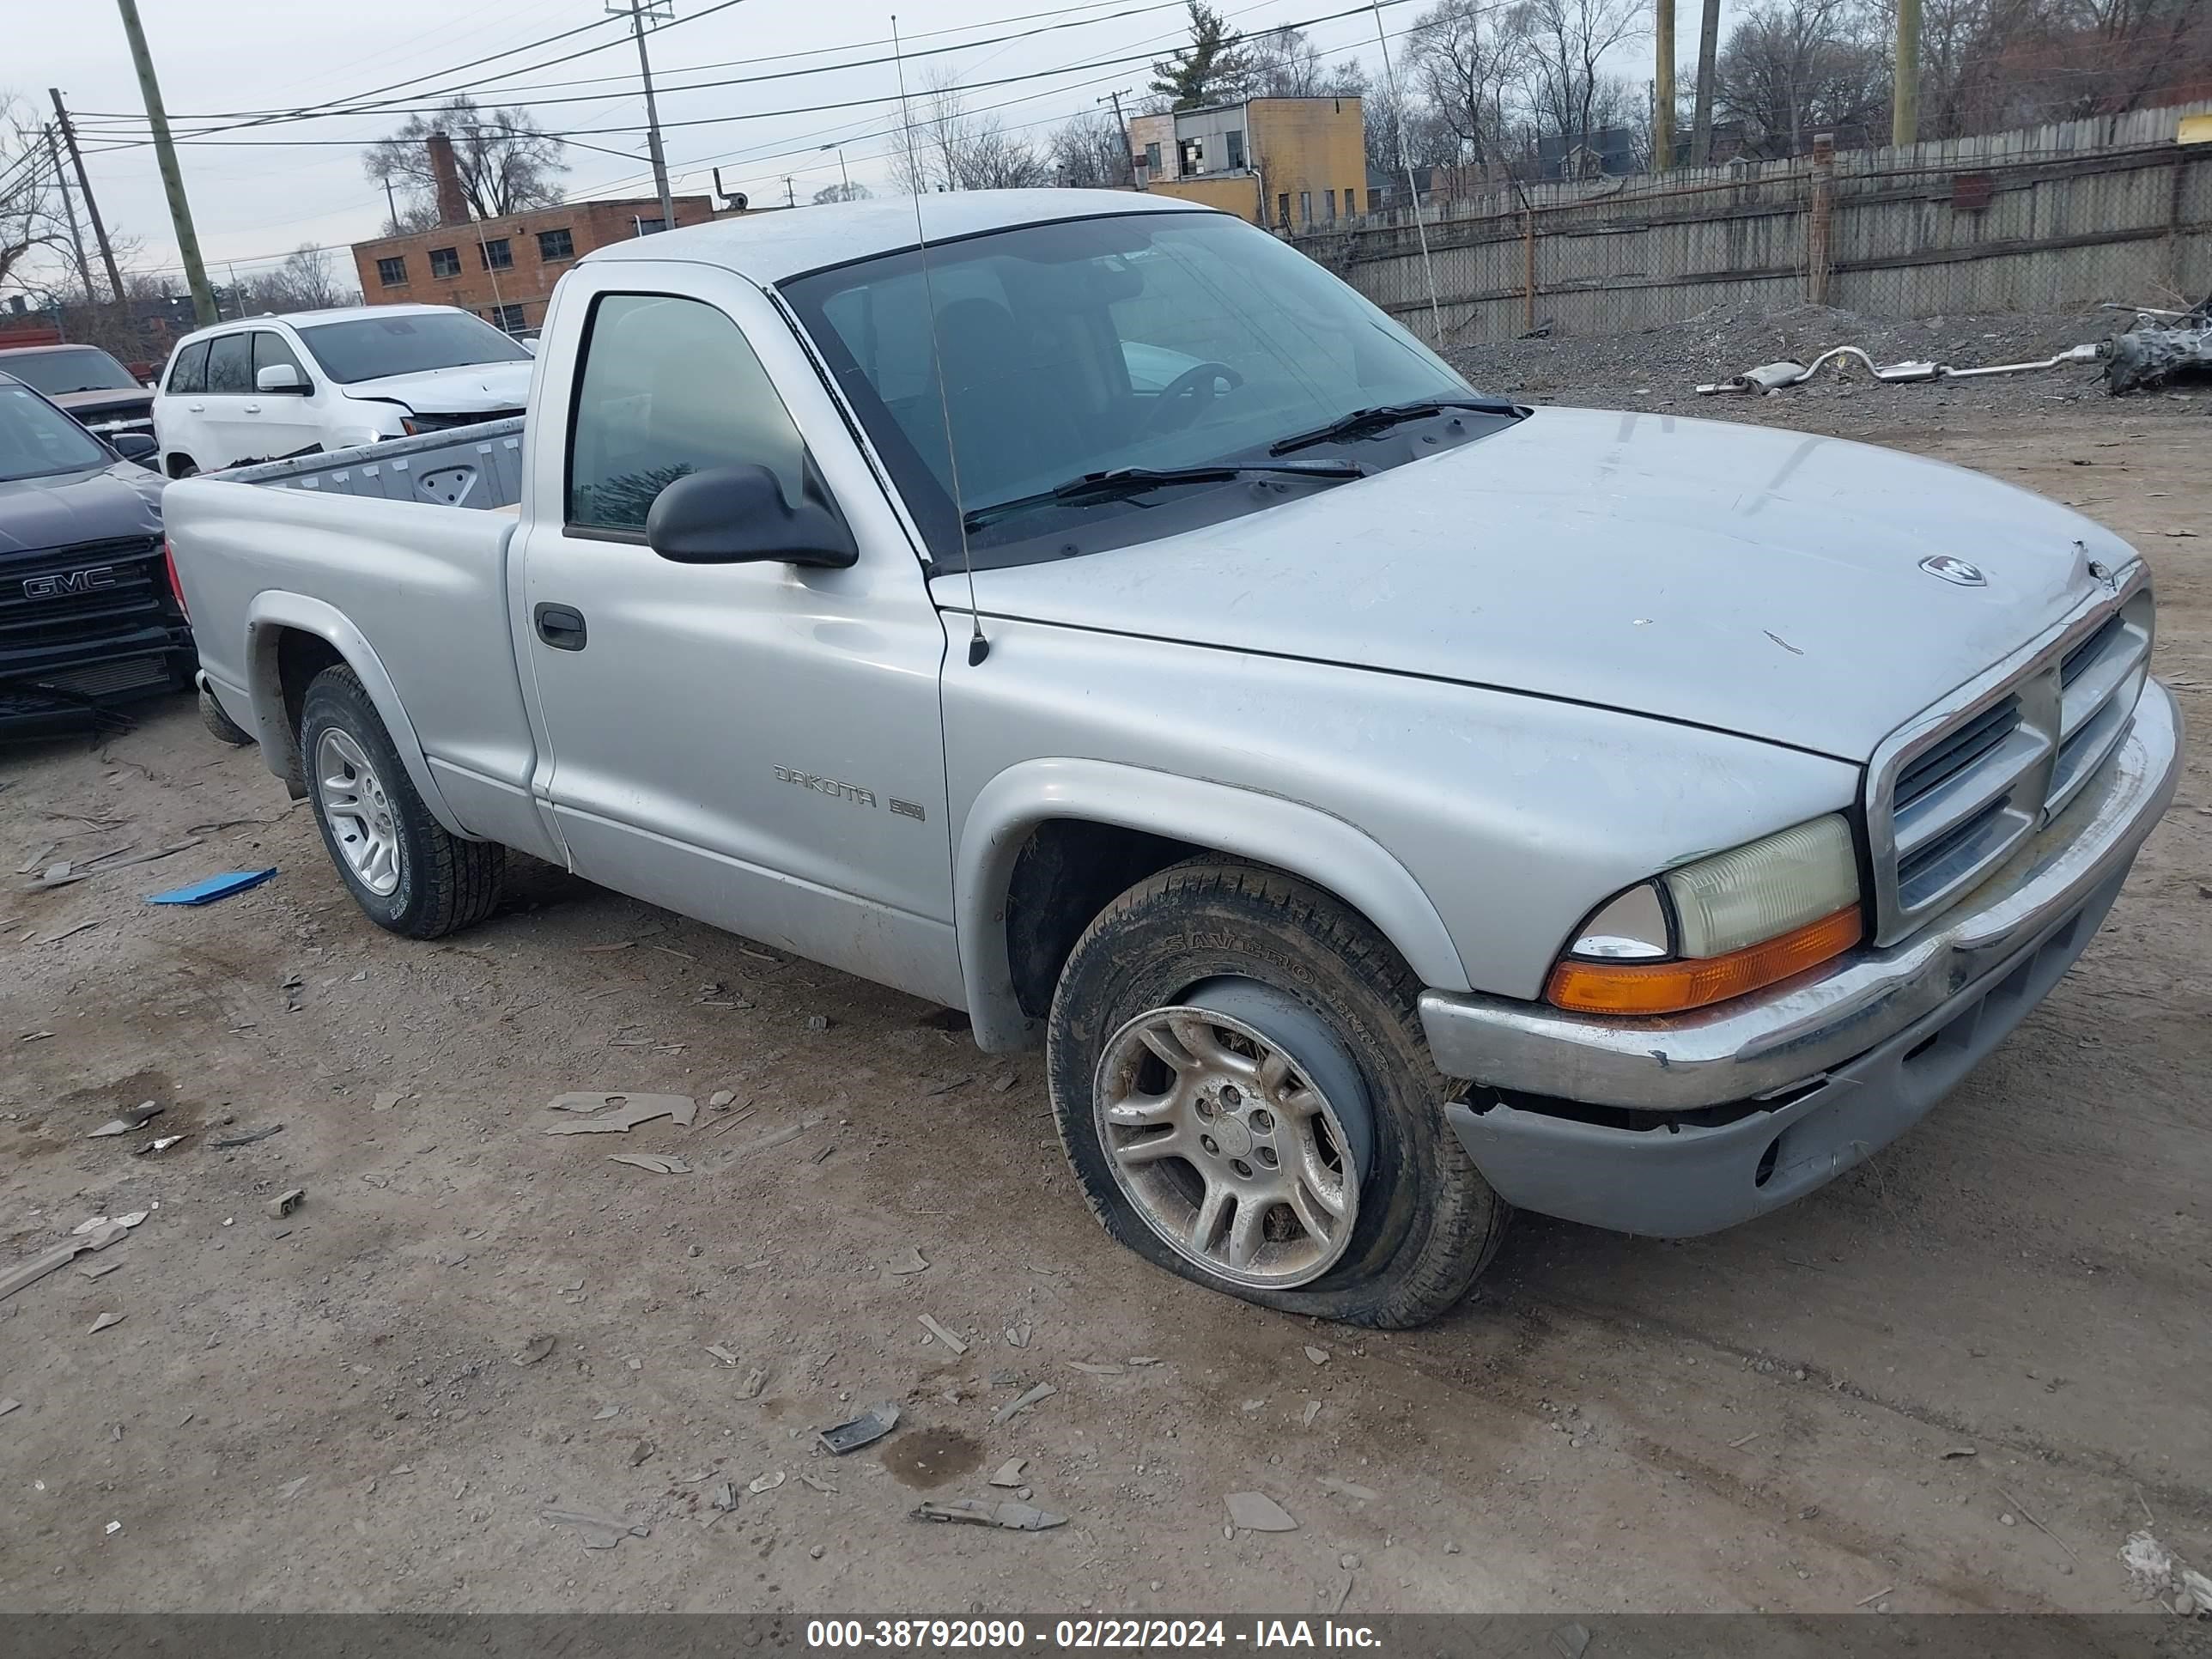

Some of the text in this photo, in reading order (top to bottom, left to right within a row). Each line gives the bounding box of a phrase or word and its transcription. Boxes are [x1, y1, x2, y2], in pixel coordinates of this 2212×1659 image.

[23, 567, 116, 599] GMC
[773, 763, 877, 808] DAKOTA
[1164, 932, 1316, 985] SAVERO
